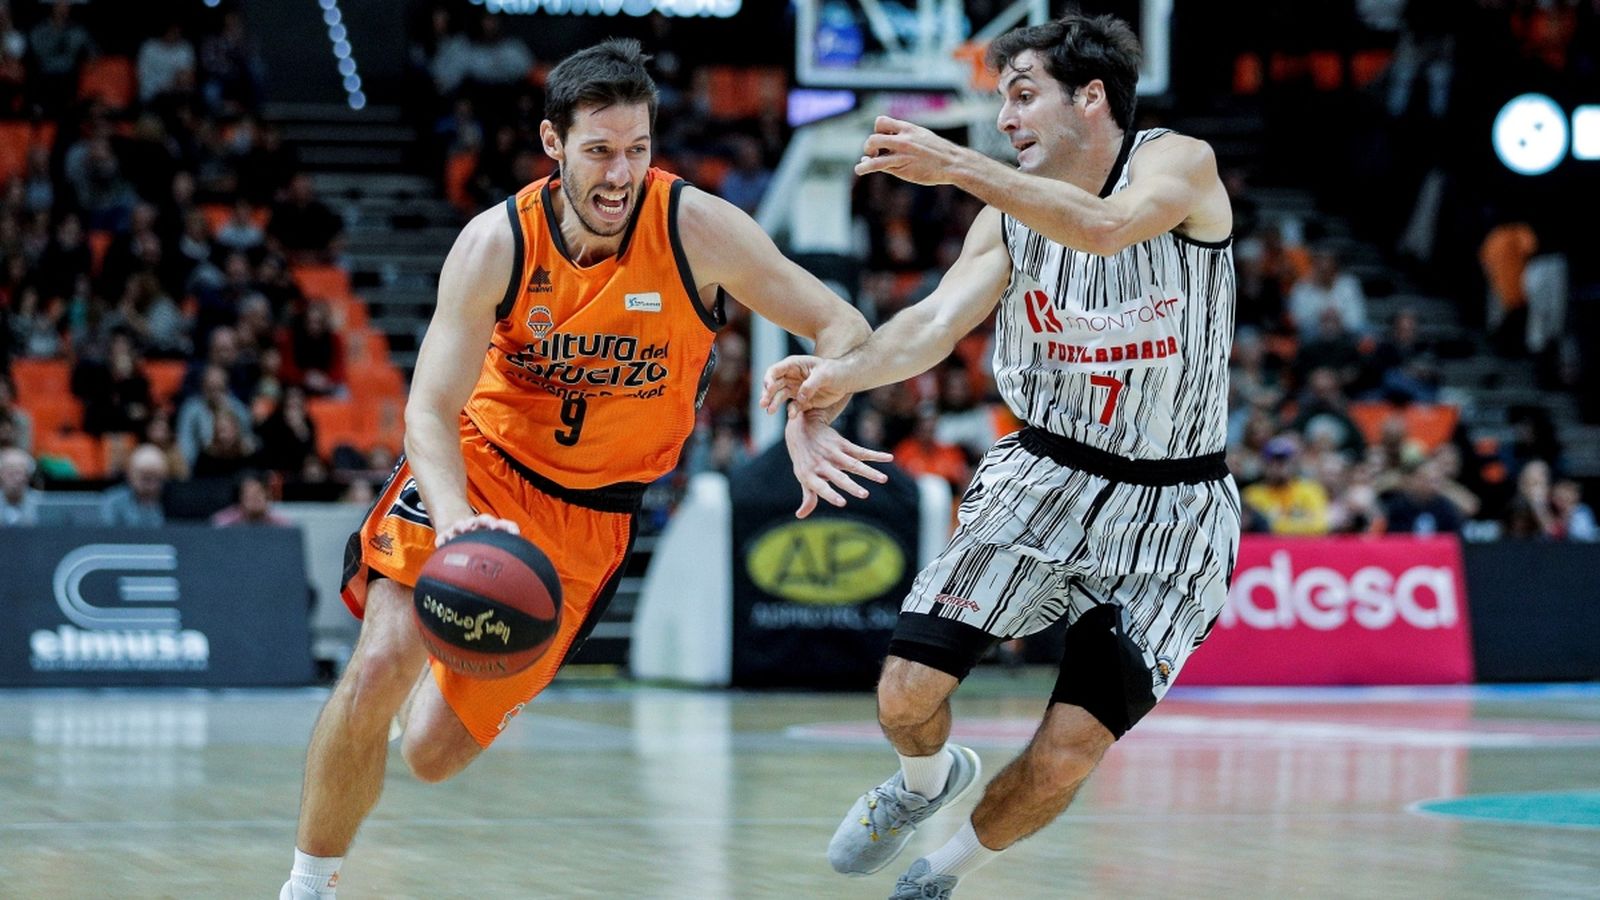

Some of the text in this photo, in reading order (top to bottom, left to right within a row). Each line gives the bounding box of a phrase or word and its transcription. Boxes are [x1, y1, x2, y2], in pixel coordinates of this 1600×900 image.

[525, 332, 669, 362] ultura del
[554, 396, 588, 447] 9
[1090, 374, 1124, 426] 7
[1218, 549, 1460, 630] desa
